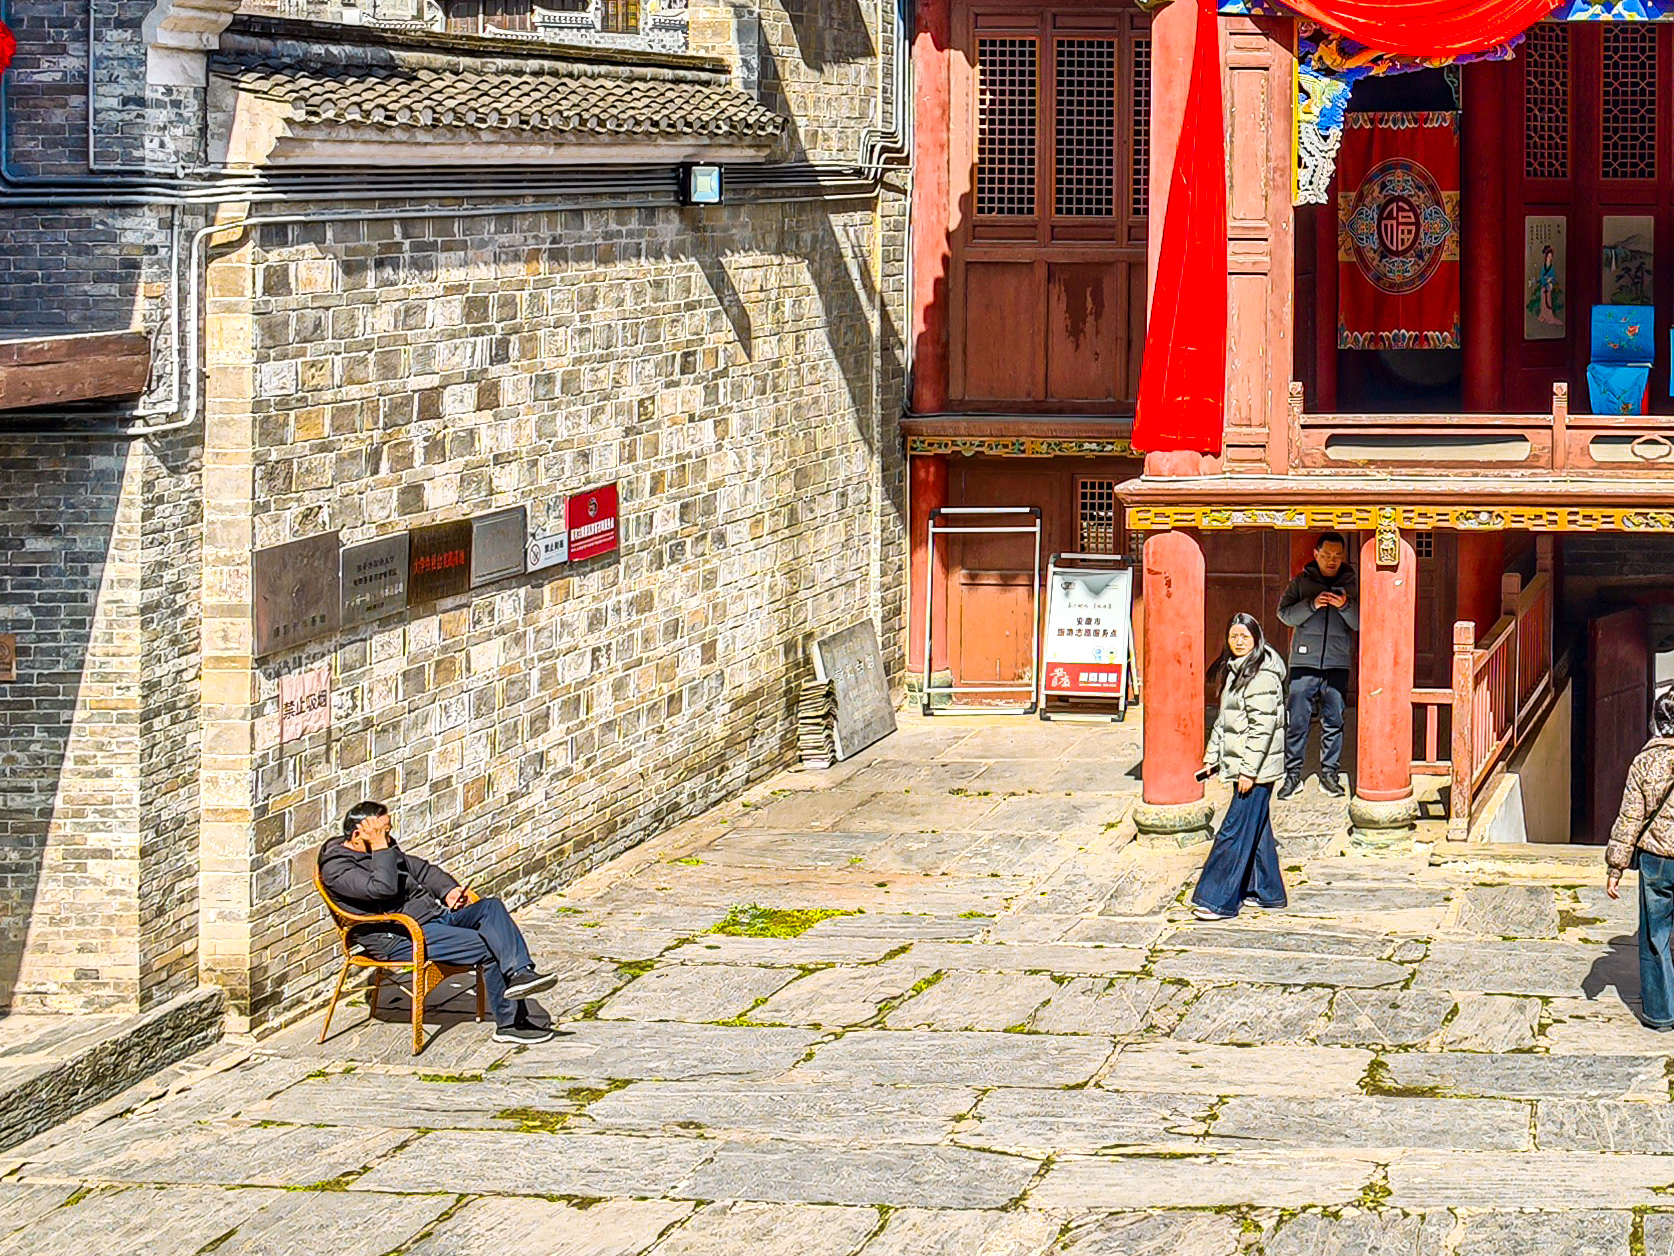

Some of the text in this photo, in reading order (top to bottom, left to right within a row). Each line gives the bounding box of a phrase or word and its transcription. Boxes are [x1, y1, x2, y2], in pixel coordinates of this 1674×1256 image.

[1381, 201, 1416, 251] 福
[283, 689, 327, 720] 禁止吸烟
